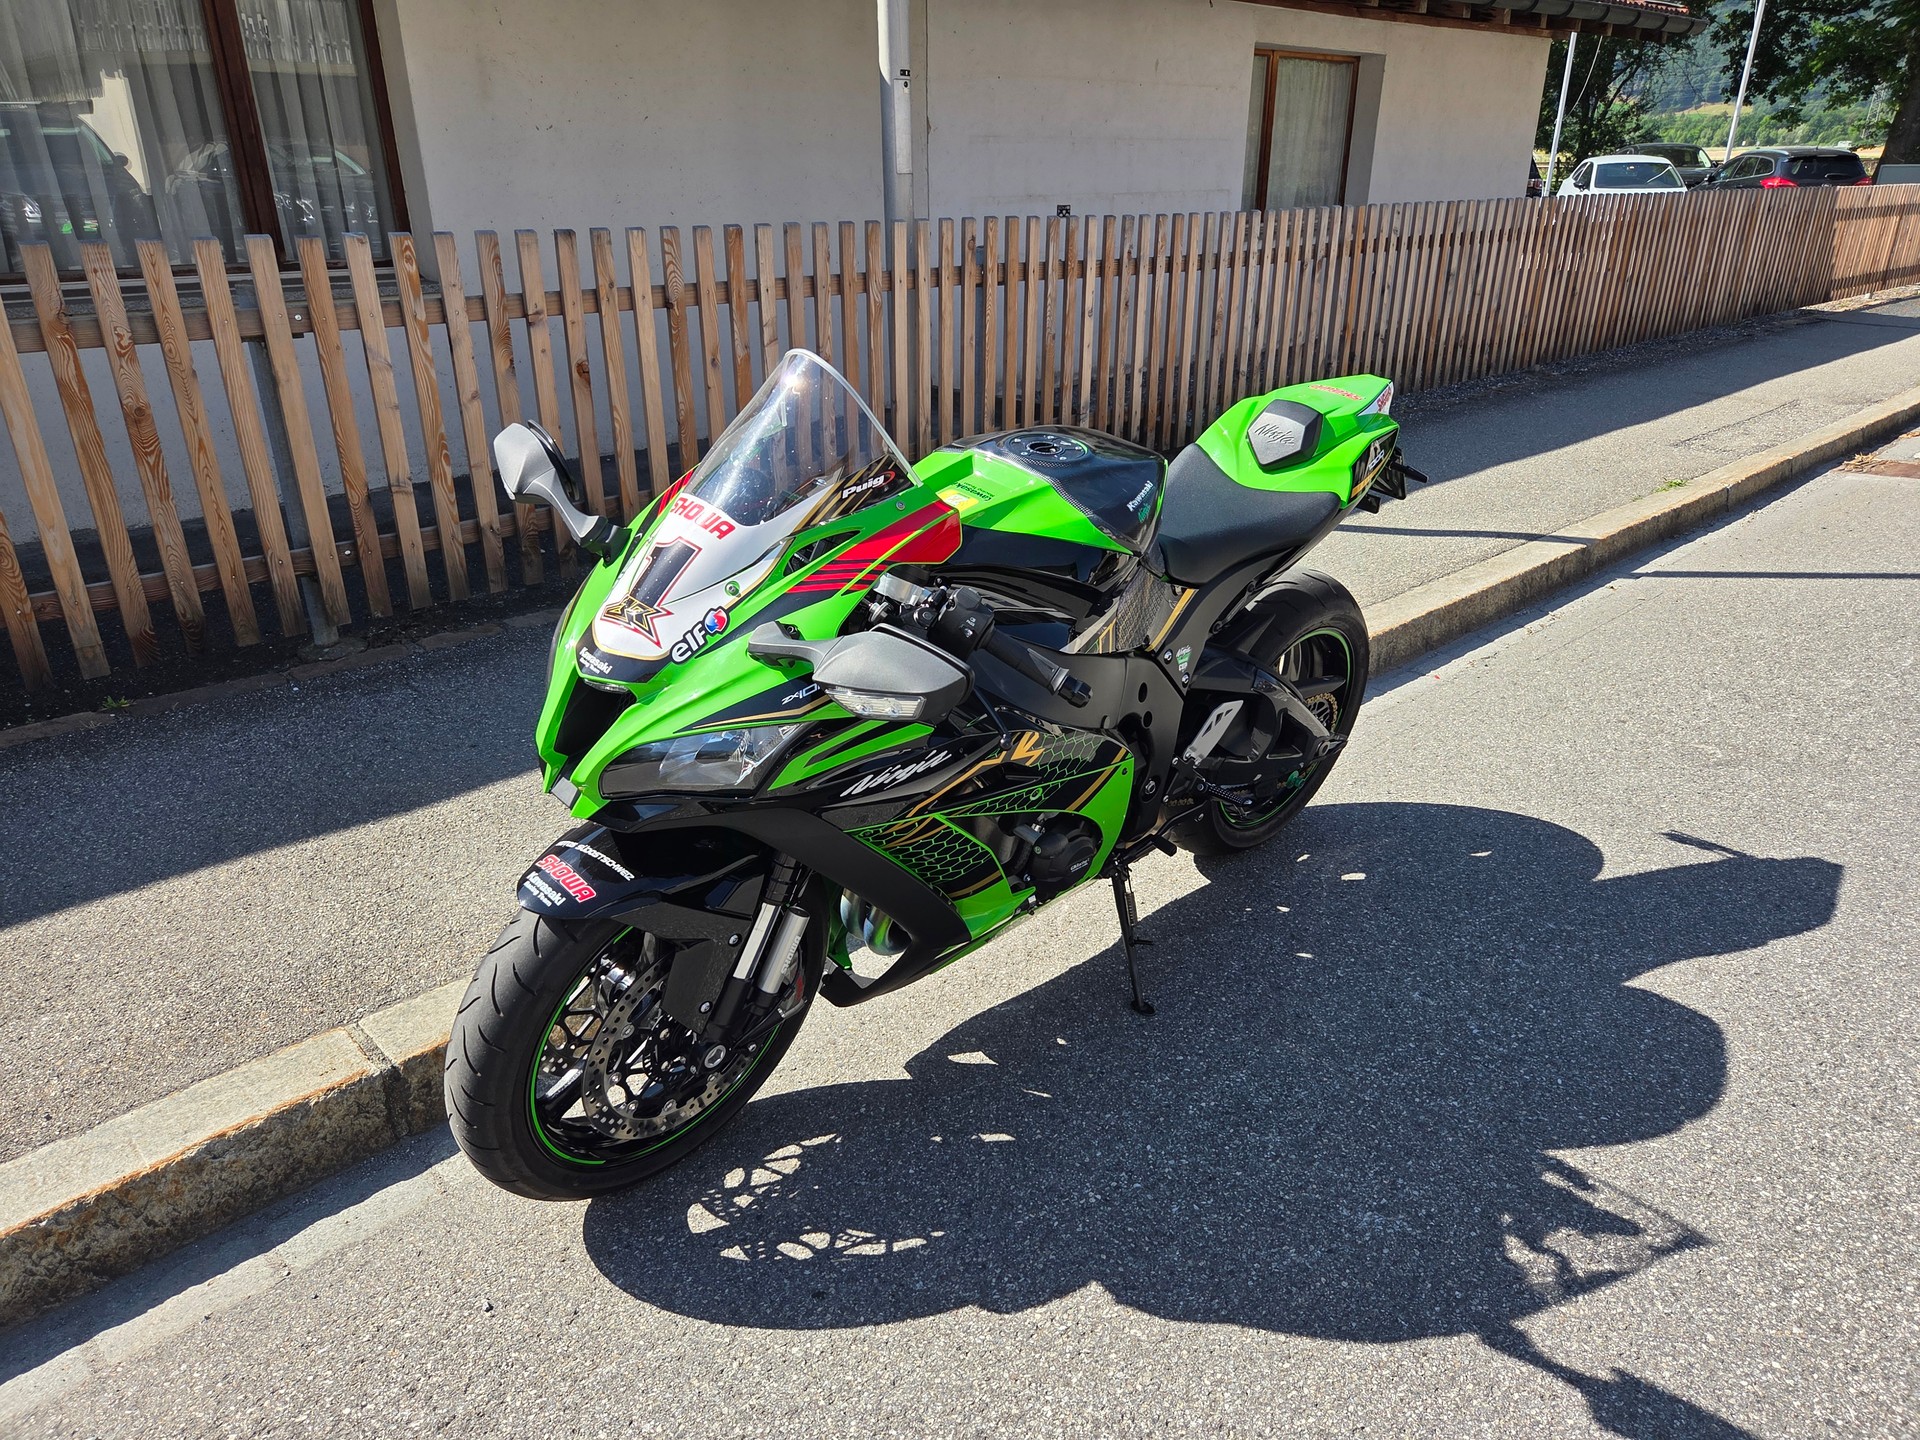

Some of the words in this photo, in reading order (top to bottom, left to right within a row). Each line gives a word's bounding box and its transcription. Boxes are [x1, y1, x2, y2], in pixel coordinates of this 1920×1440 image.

[1254, 423, 1296, 446] Ninja
[842, 473, 885, 499] Puig
[1126, 480, 1154, 512] Kawasaki
[670, 497, 736, 540] SHOWA
[579, 646, 613, 675] Kawasaki
[671, 624, 706, 662] elf
[839, 749, 952, 798] Ninja
[526, 871, 567, 907] Kawasaki
[535, 854, 597, 903] SHOWA
[780, 935, 801, 974] SHOWA
